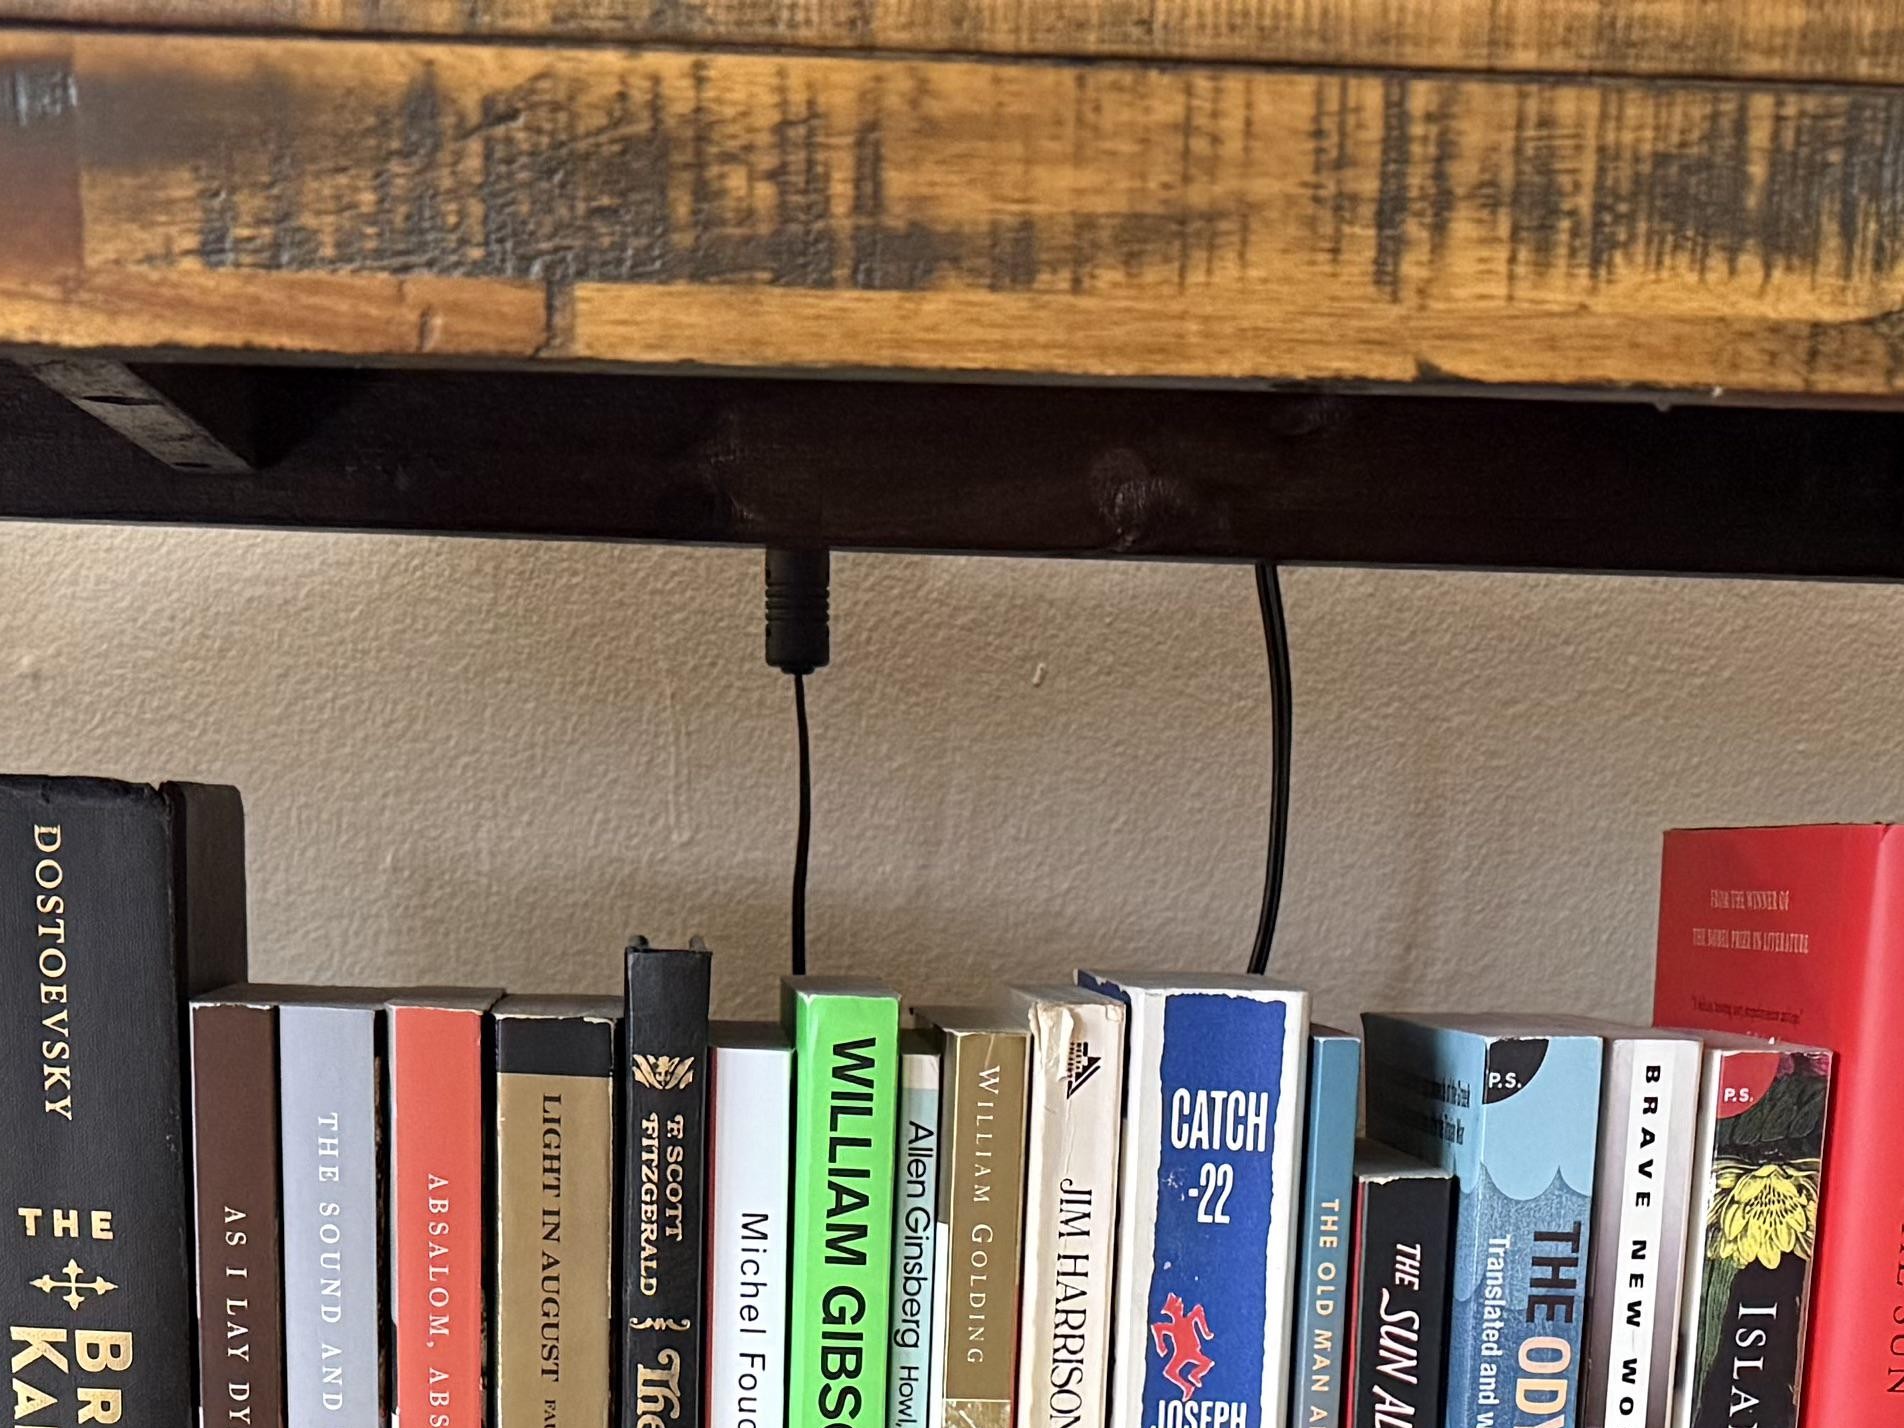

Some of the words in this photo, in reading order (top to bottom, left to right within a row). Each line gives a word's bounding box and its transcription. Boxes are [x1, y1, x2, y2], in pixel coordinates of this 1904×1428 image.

[34, 823, 72, 1121] DOSTOEVSKY
[1488, 1070, 1522, 1089] P.S.
[1170, 1089, 1267, 1152] CATCH
[822, 1036, 878, 1269] WILLIAM
[18, 1208, 114, 1241] THE
[1187, 1162, 1234, 1225] -22
[1525, 1220, 1582, 1325] THE
